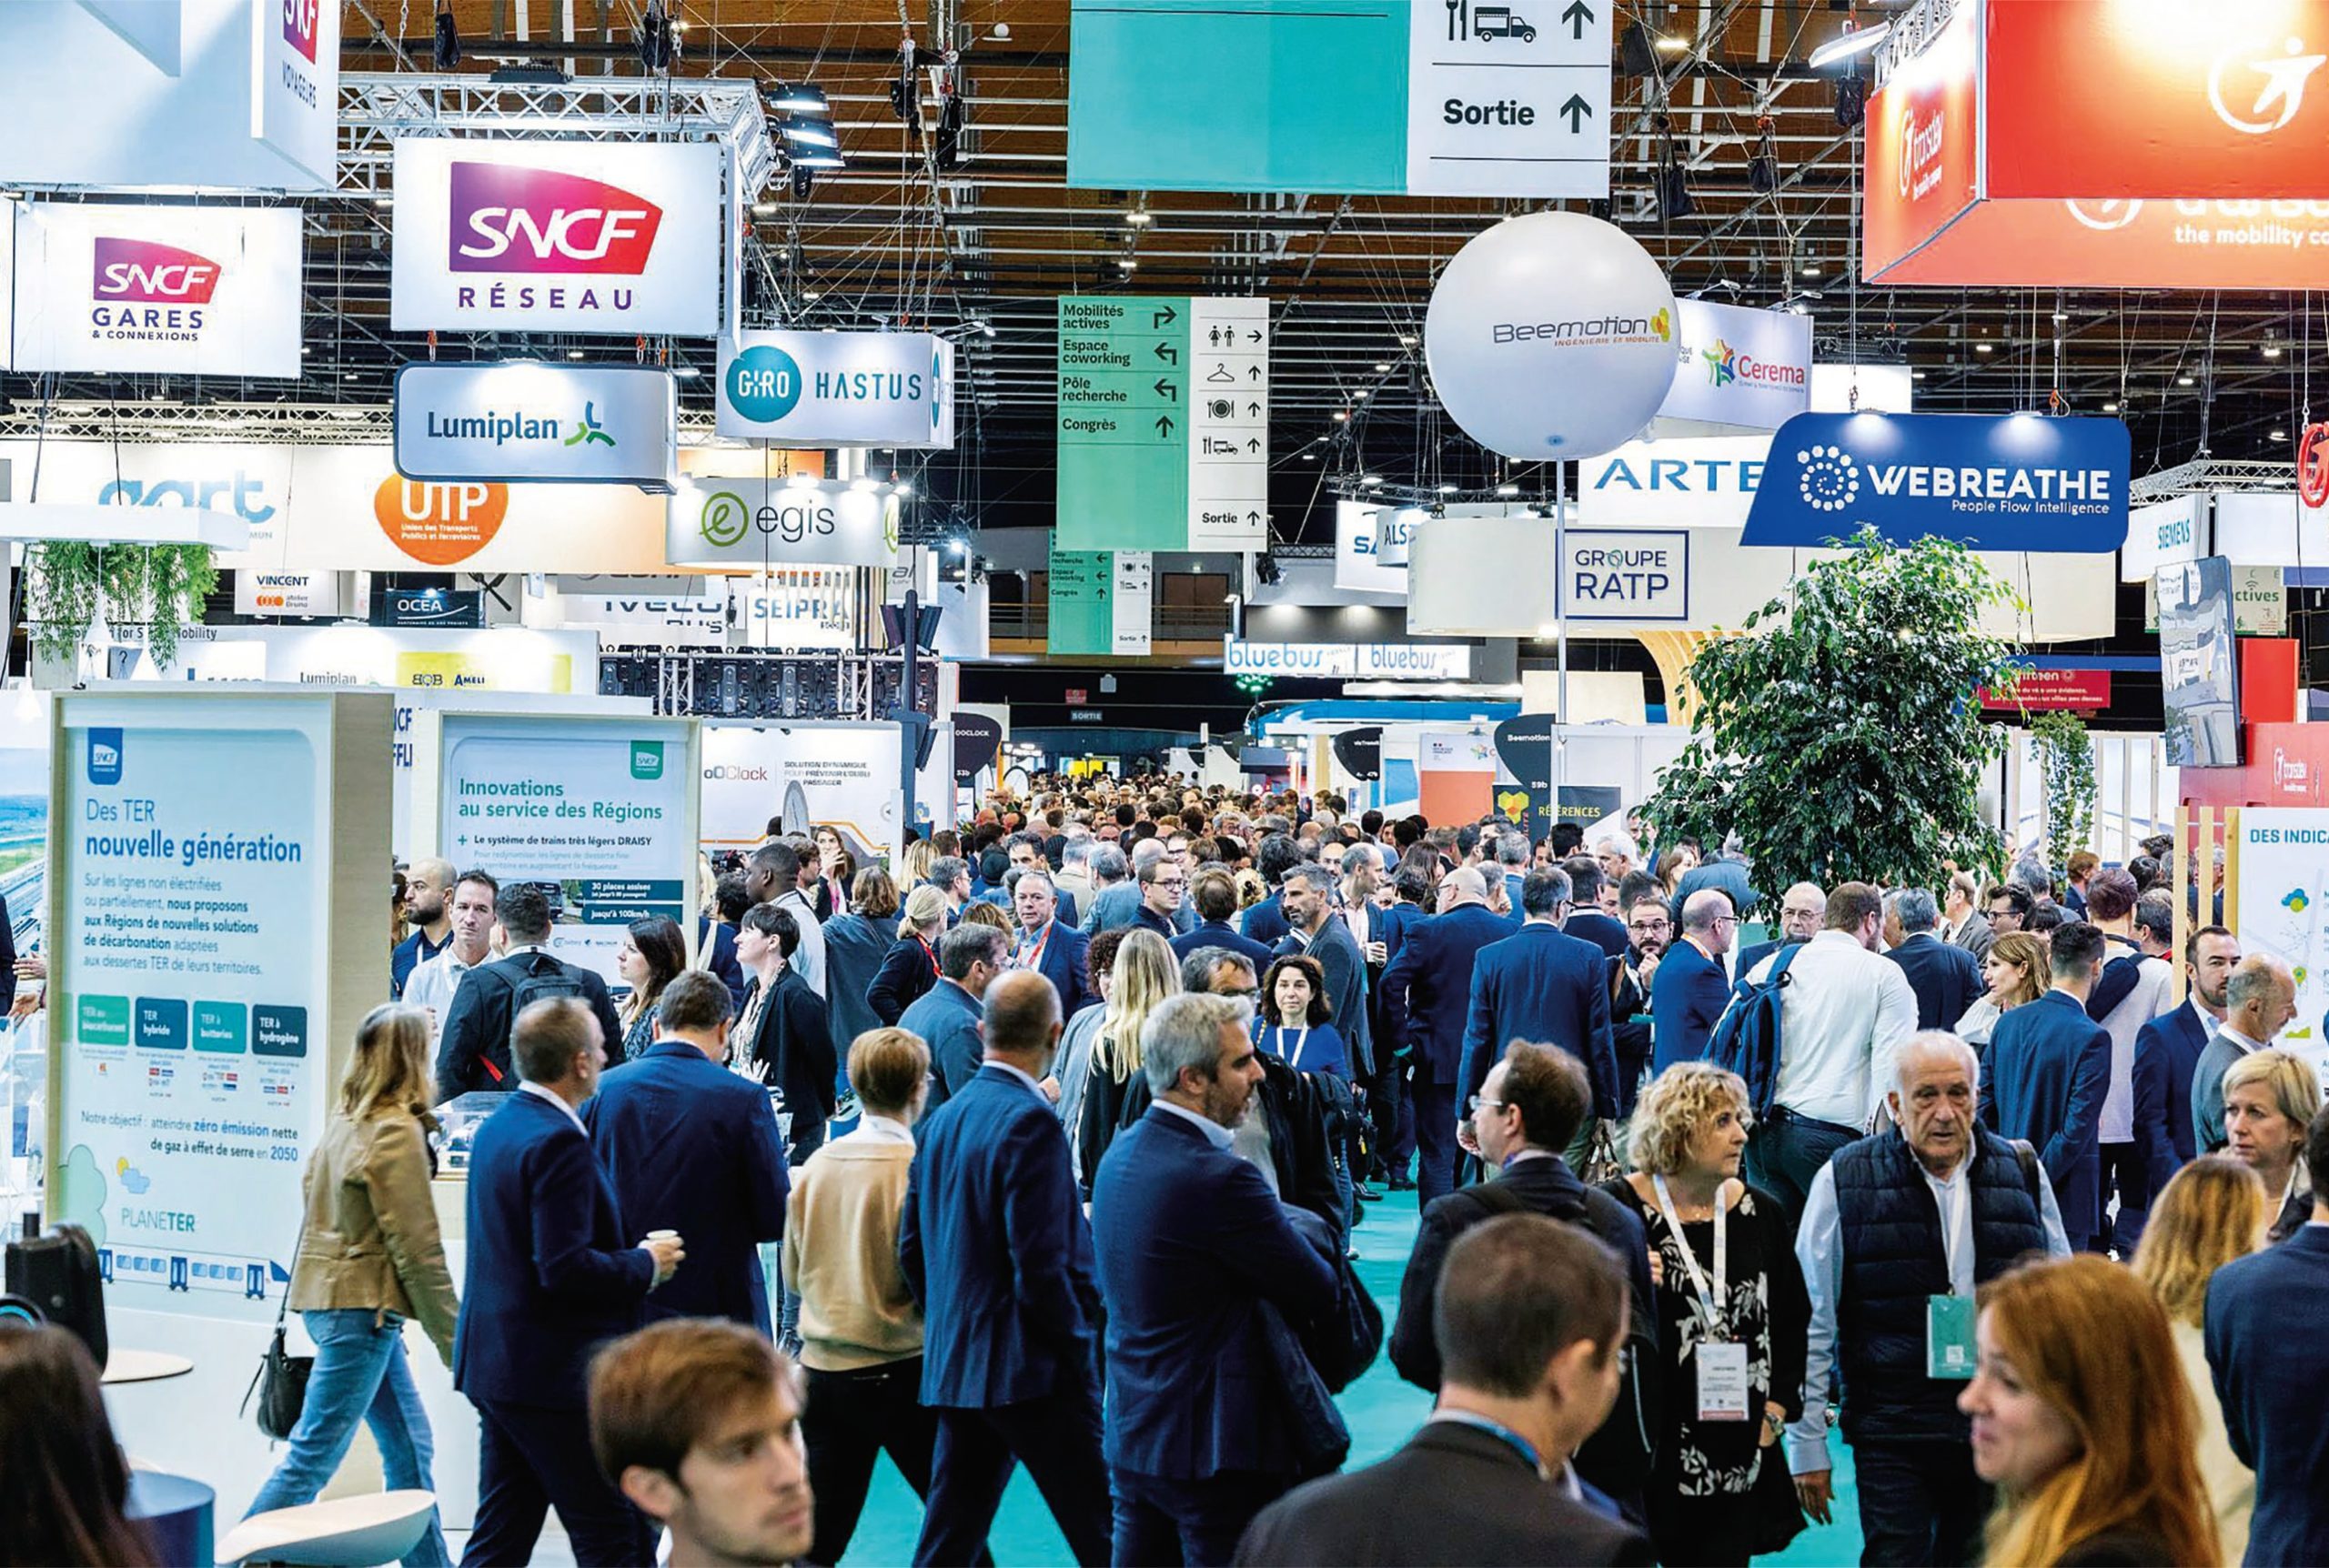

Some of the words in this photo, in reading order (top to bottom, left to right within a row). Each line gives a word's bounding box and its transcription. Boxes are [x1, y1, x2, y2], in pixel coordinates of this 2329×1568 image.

[1442, 98, 1535, 126] Sortie
[459, 207, 647, 260] SNCF
[2175, 225, 2209, 244] the
[2216, 225, 2304, 248] mobility
[98, 263, 213, 295] SNCF
[459, 283, 632, 310] RÉSEAU
[92, 307, 203, 329] GARES
[1064, 305, 1124, 316] Mobilités
[1064, 317, 1110, 329] actives
[1493, 317, 1648, 343] Beemotion
[92, 330, 100, 339] &
[107, 330, 198, 342] CONNEXIONS
[1064, 339, 1108, 352] Espace
[1063, 353, 1130, 367] coworking
[1739, 355, 1805, 385] Cerema
[738, 370, 790, 398] GIRO
[815, 372, 922, 401] HASTUS
[1063, 377, 1090, 388] Pôle
[1063, 389, 1127, 402] recherche
[428, 411, 559, 445] Lumiplan
[1063, 418, 1116, 433] Congrès
[1594, 458, 1765, 492] ARTE
[1867, 465, 2111, 500] WEBREATHE
[401, 482, 489, 521] UTP
[1952, 499, 1996, 514] People
[2001, 500, 2032, 513] Flow
[2035, 500, 2110, 517] Intelligence
[756, 498, 835, 543] egis
[1202, 512, 1237, 524] Sortie
[1384, 524, 1409, 546] ALS
[2158, 518, 2191, 550] SIEMENS
[1575, 549, 1667, 569] GROUPE
[1576, 573, 1669, 600] RATP
[2233, 590, 2279, 602] ctives
[398, 599, 443, 612] OCEA
[754, 598, 849, 619] SEIPRA
[1228, 641, 1324, 667] bluebus
[1371, 644, 1437, 669] bluebus
[300, 671, 357, 684] Lumiplan
[459, 778, 564, 797] Innovations
[86, 799, 117, 821] Des
[123, 799, 155, 822] TER
[459, 804, 479, 817] au
[487, 801, 549, 818] service
[555, 800, 586, 818] des
[593, 801, 662, 822] Régions
[1538, 805, 1600, 818] RÉÉRENCES
[474, 836, 485, 845] Le
[487, 835, 525, 847] système
[528, 836, 539, 845] de
[541, 836, 566, 845] trains
[569, 836, 586, 846] très
[589, 836, 615, 848] légers
[618, 837, 652, 846] DRAISY
[2250, 829, 2280, 844] DES
[86, 829, 175, 858] nouvelle
[182, 832, 301, 867] génération
[85, 872, 101, 886] Sur
[103, 873, 116, 887] les
[118, 874, 146, 891] lignes
[149, 878, 166, 889] non
[602, 882, 625, 891] places
[85, 896, 96, 906] ou
[167, 900, 190, 910] nous
[194, 900, 248, 914] proposons
[85, 915, 101, 926] aux
[105, 914, 144, 930] Régions
[146, 915, 159, 929] de
[162, 917, 210, 931] nouvelles
[213, 920, 259, 934] solutions
[84, 933, 96, 946] de
[99, 933, 171, 950] décarbonation
[174, 938, 218, 954] adaptées
[84, 955, 100, 967] aux
[102, 954, 147, 969] dessertes
[150, 956, 168, 970] TER
[171, 958, 185, 971] de
[187, 958, 210, 972] leurs
[144, 1010, 157, 1020] TER
[201, 1013, 215, 1024] TER
[259, 1018, 275, 1029] TER
[143, 1023, 170, 1037] hybride
[259, 1031, 300, 1046] hydrogène
[81, 1111, 106, 1124] Notre
[108, 1113, 142, 1130] objectif
[151, 1118, 191, 1131] atteindre
[194, 1121, 217, 1132] zéro
[221, 1120, 269, 1137] émission
[272, 1129, 298, 1140] nette
[150, 1138, 162, 1151] de
[165, 1141, 181, 1154] gaz
[184, 1141, 188, 1152] à
[191, 1140, 214, 1154] effet
[217, 1142, 227, 1156] de
[230, 1148, 254, 1158] serre
[257, 1149, 268, 1158] en
[271, 1146, 298, 1161] 2050
[122, 1208, 196, 1231] PLANETER
